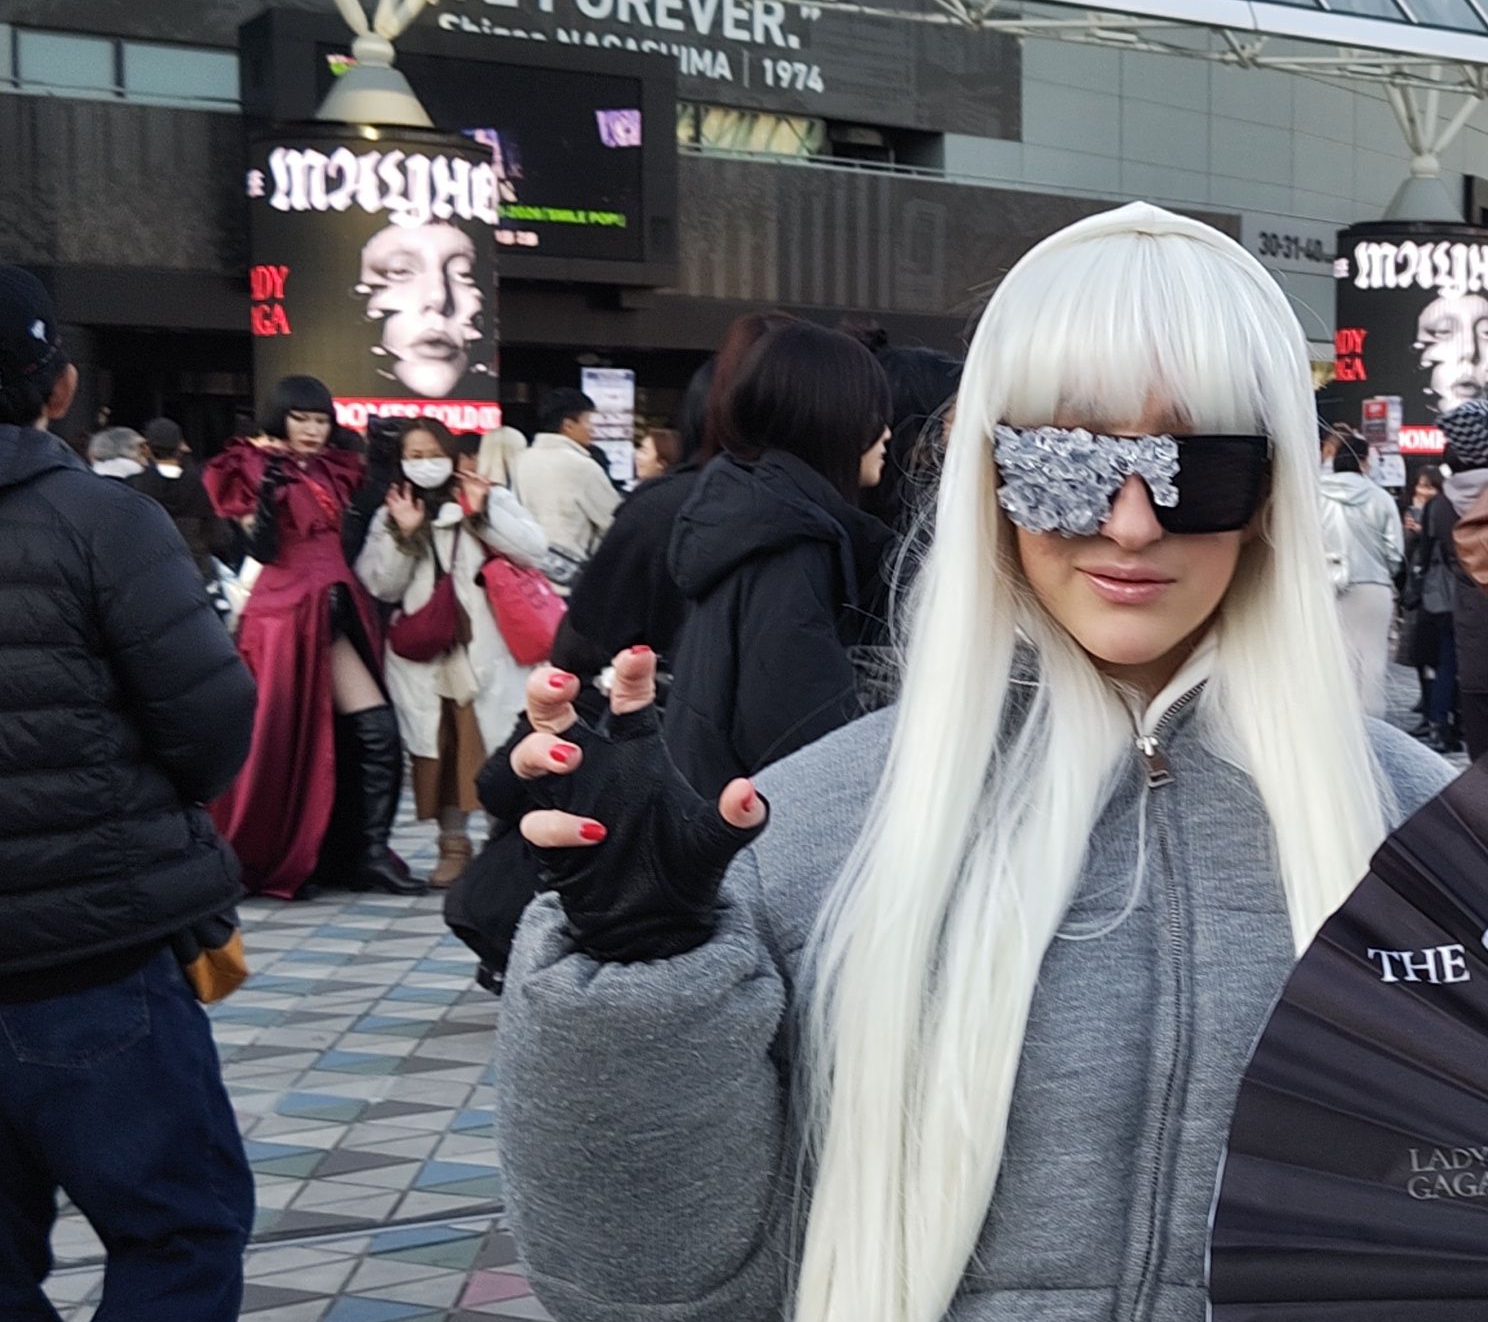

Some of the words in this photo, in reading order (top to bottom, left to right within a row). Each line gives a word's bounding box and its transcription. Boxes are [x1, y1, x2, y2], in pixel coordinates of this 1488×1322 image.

[761, 57, 825, 94] 1974
[269, 146, 498, 228] MAYHE
[250, 264, 290, 300] DY
[250, 304, 292, 336] GA
[1367, 943, 1471, 985] THE
